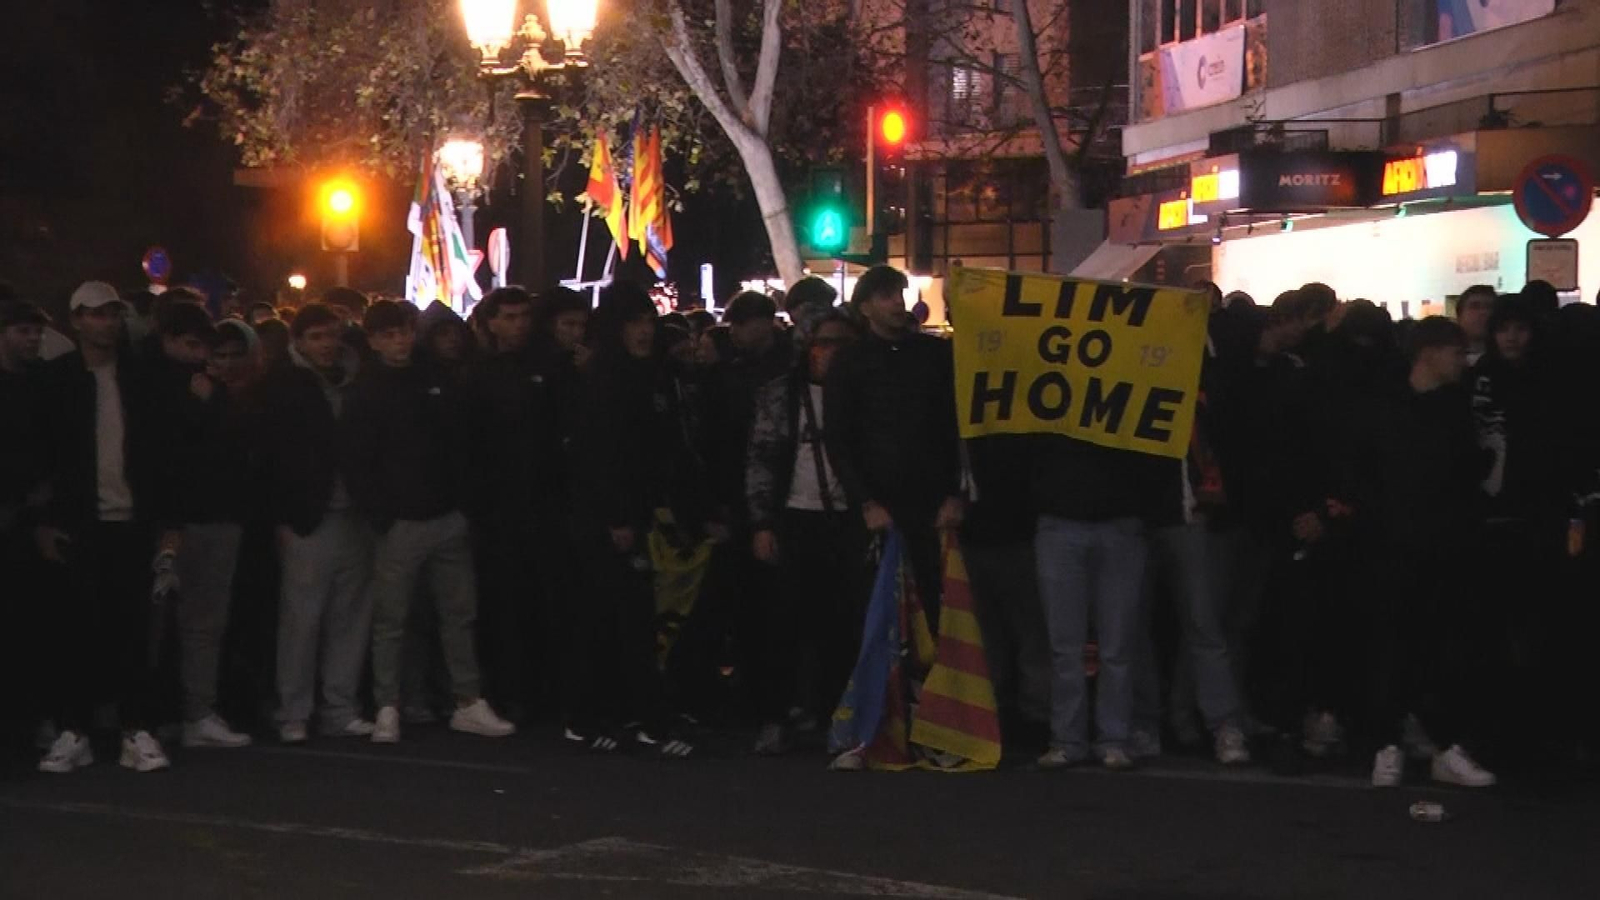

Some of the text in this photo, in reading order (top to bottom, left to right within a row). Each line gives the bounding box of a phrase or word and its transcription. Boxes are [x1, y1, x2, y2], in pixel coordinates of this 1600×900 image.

[1279, 174, 1341, 187] MORITZ
[1002, 275, 1157, 327] LIM
[1038, 326, 1112, 367] GO
[970, 371, 1185, 442] HOME
